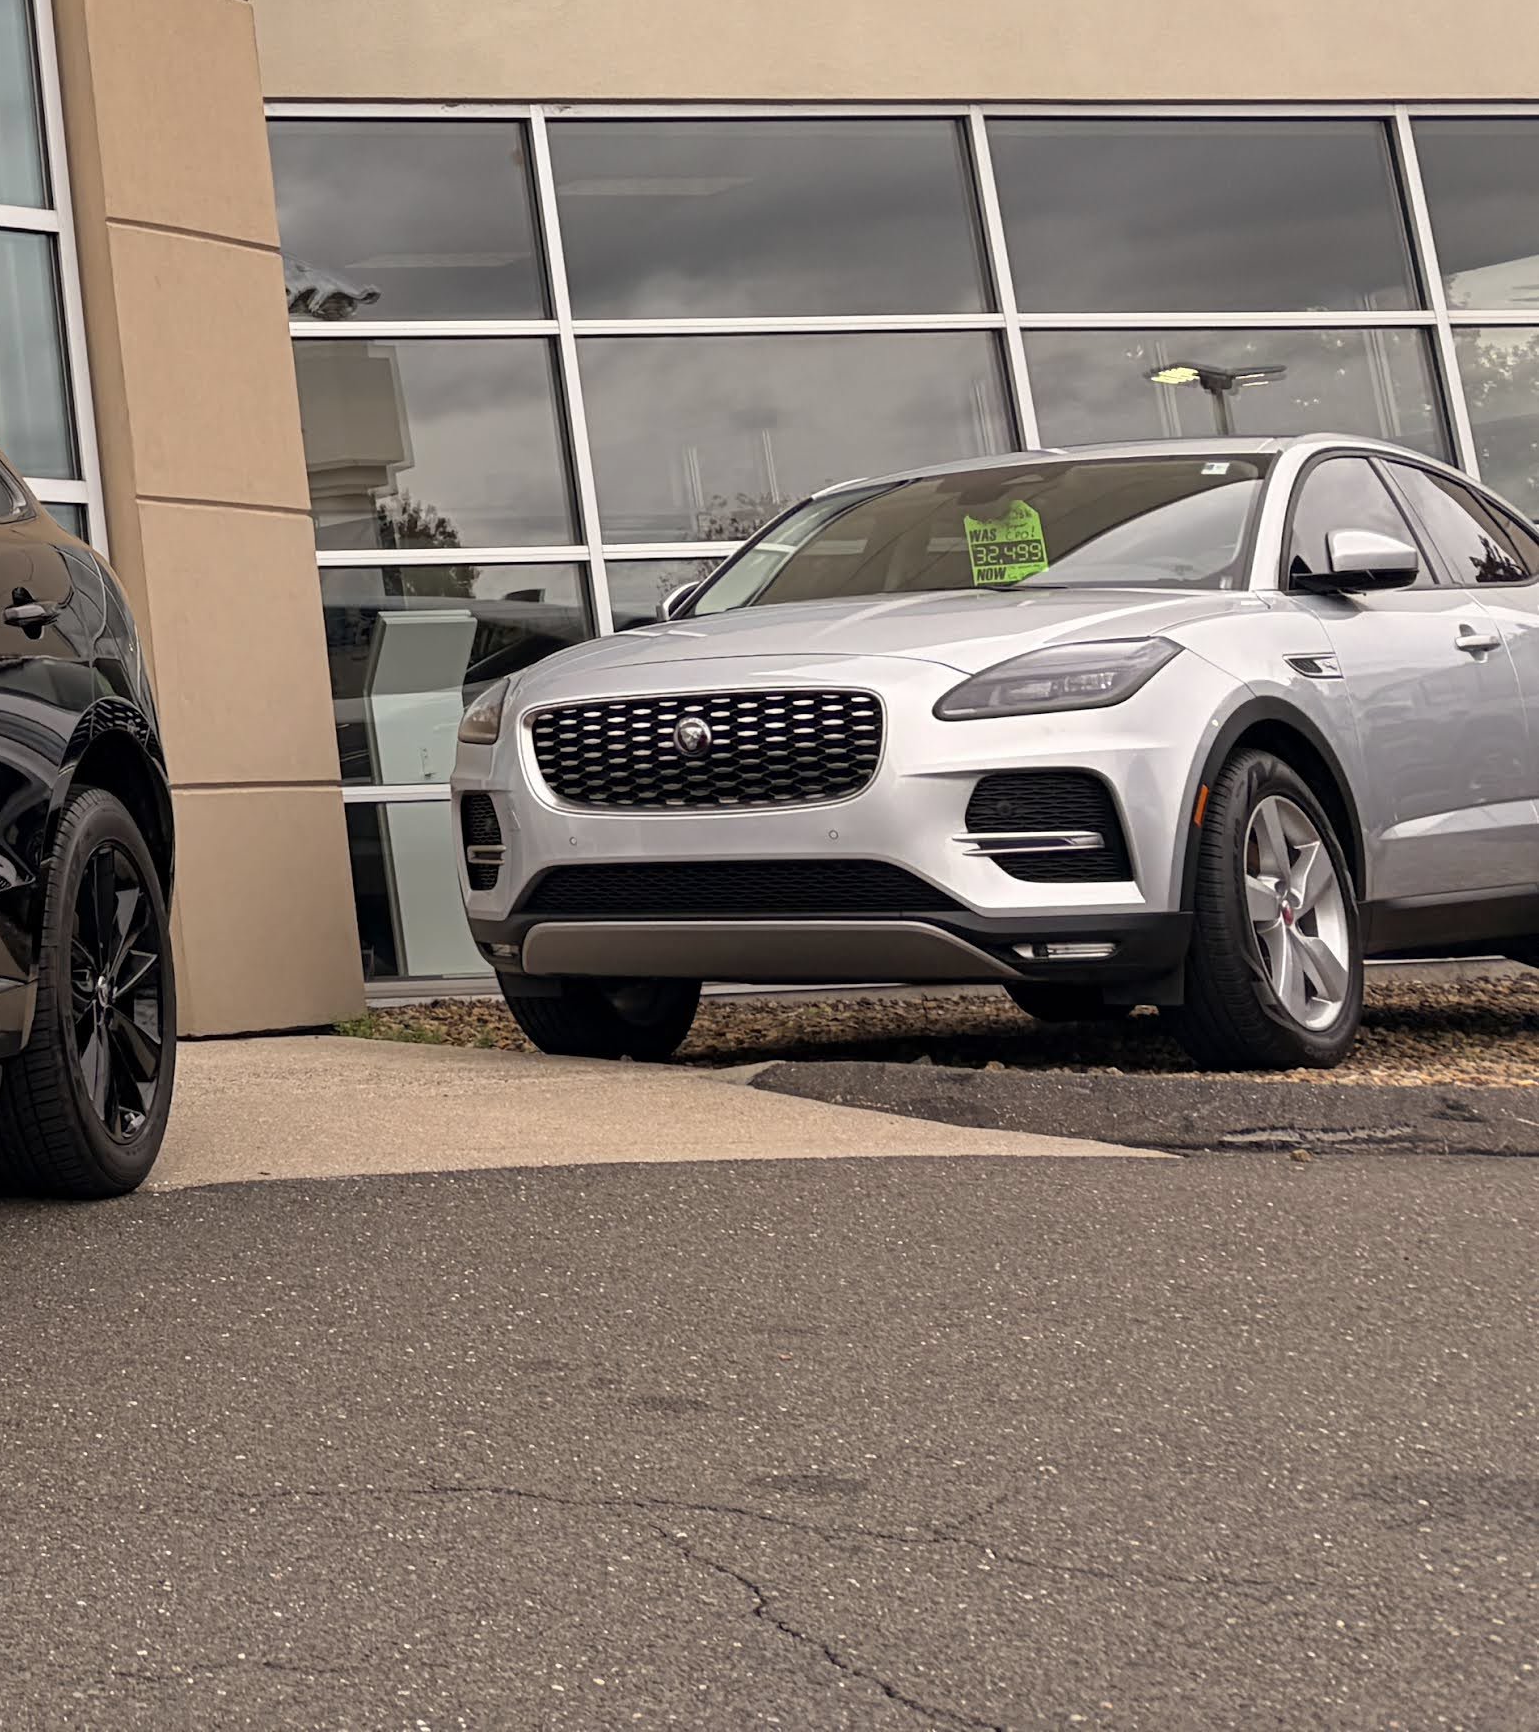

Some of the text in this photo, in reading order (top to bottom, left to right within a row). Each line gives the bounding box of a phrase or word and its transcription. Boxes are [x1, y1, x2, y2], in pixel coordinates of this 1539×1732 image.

[968, 528, 997, 542] WAS
[976, 542, 1042, 564] 32,499
[976, 566, 1007, 581] NOW
